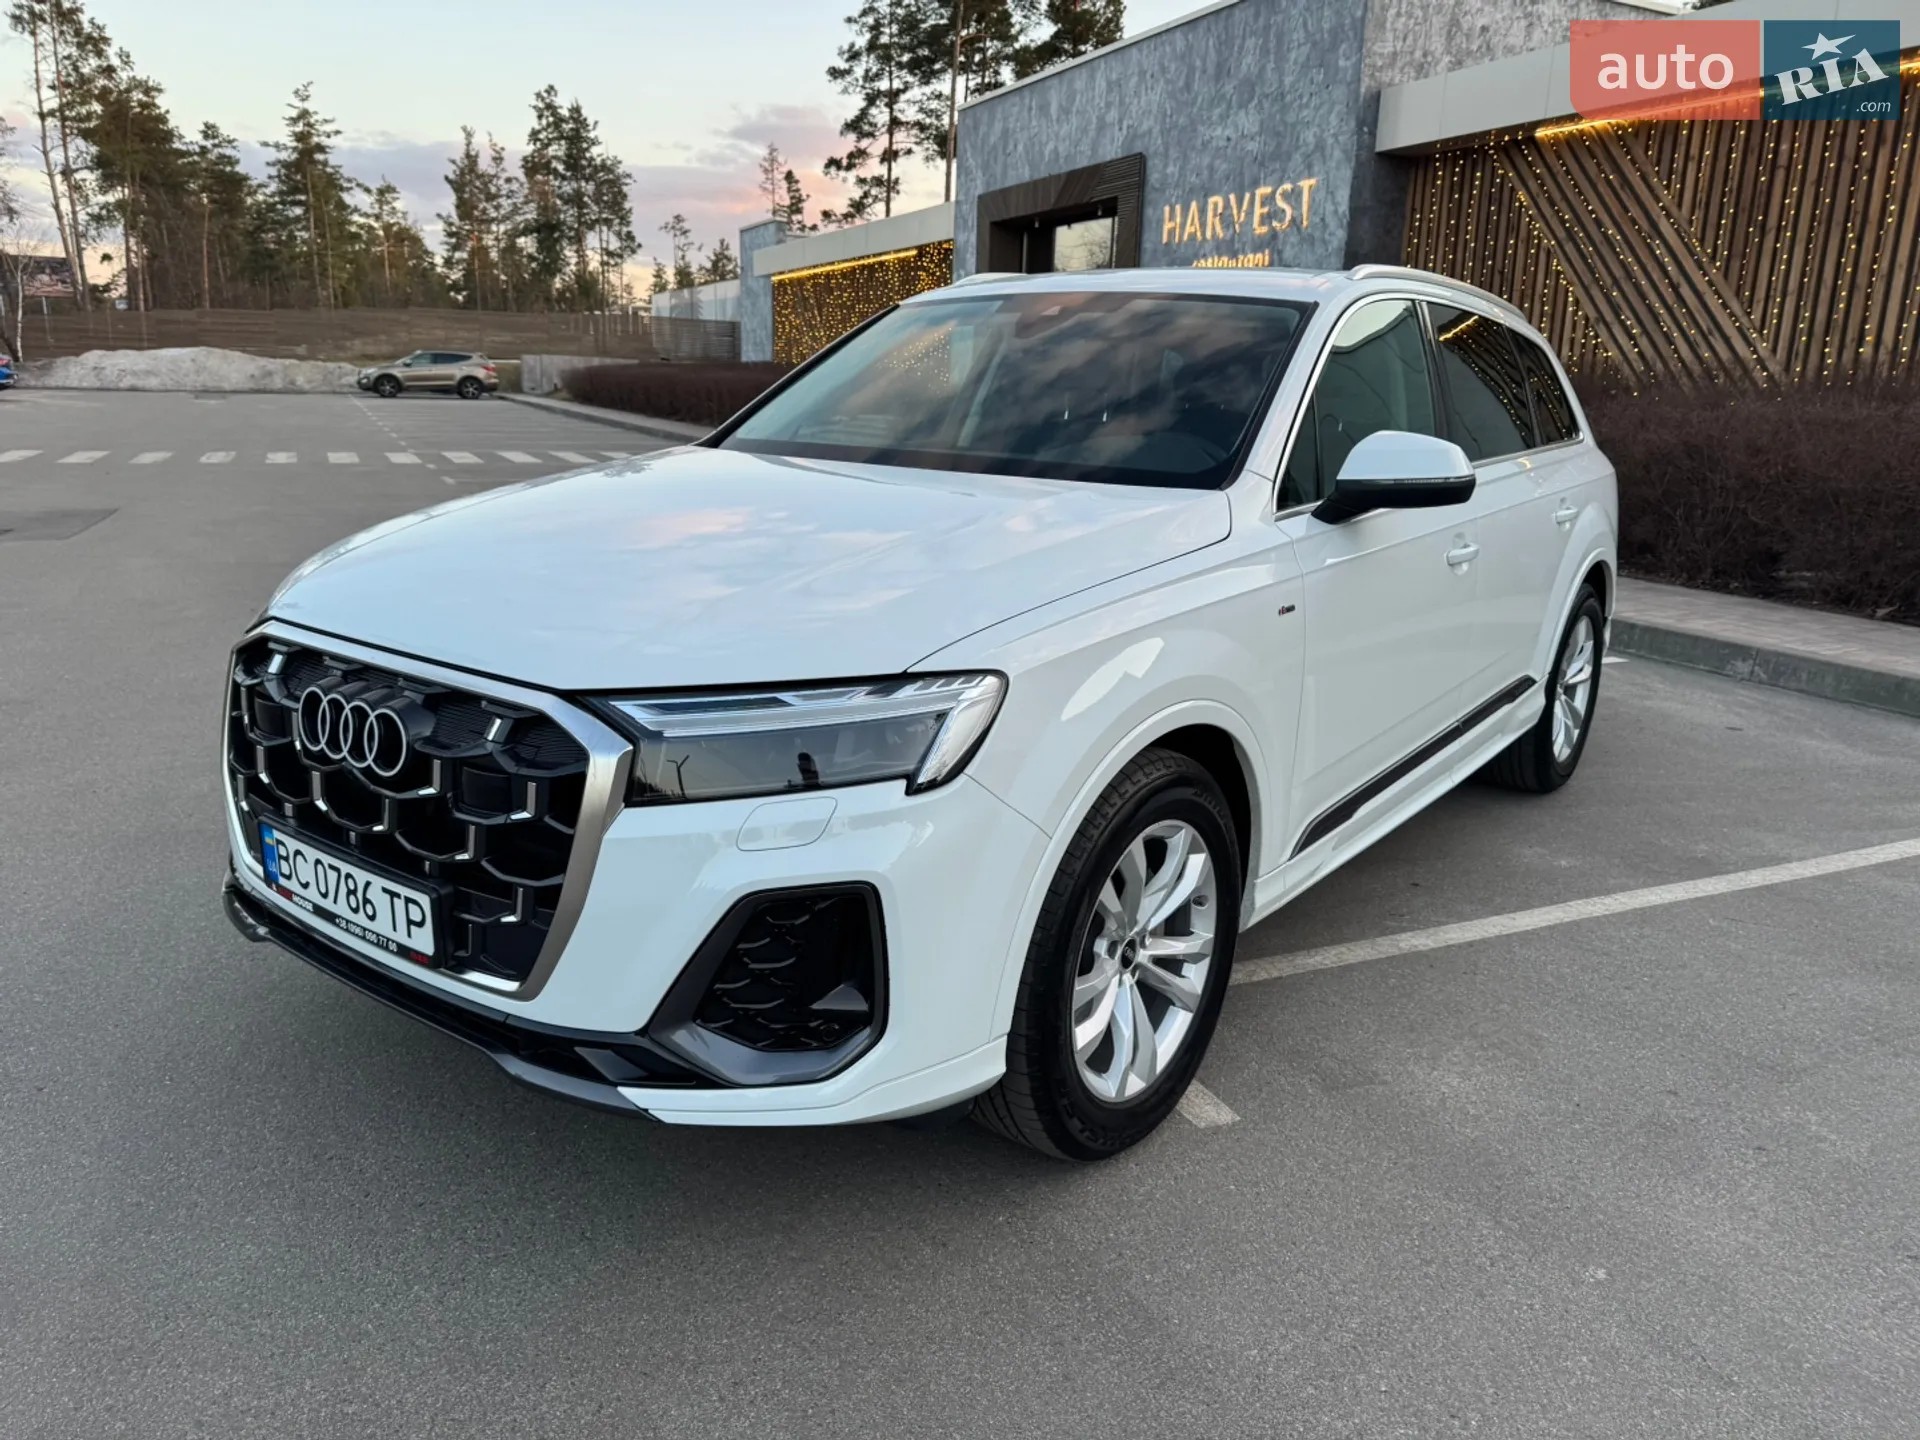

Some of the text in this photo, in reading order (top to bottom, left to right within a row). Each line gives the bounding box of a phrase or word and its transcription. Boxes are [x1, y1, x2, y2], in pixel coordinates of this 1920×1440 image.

[1162, 177, 1319, 244] HARVEST
[275, 837, 427, 939] BC 0786 TP
